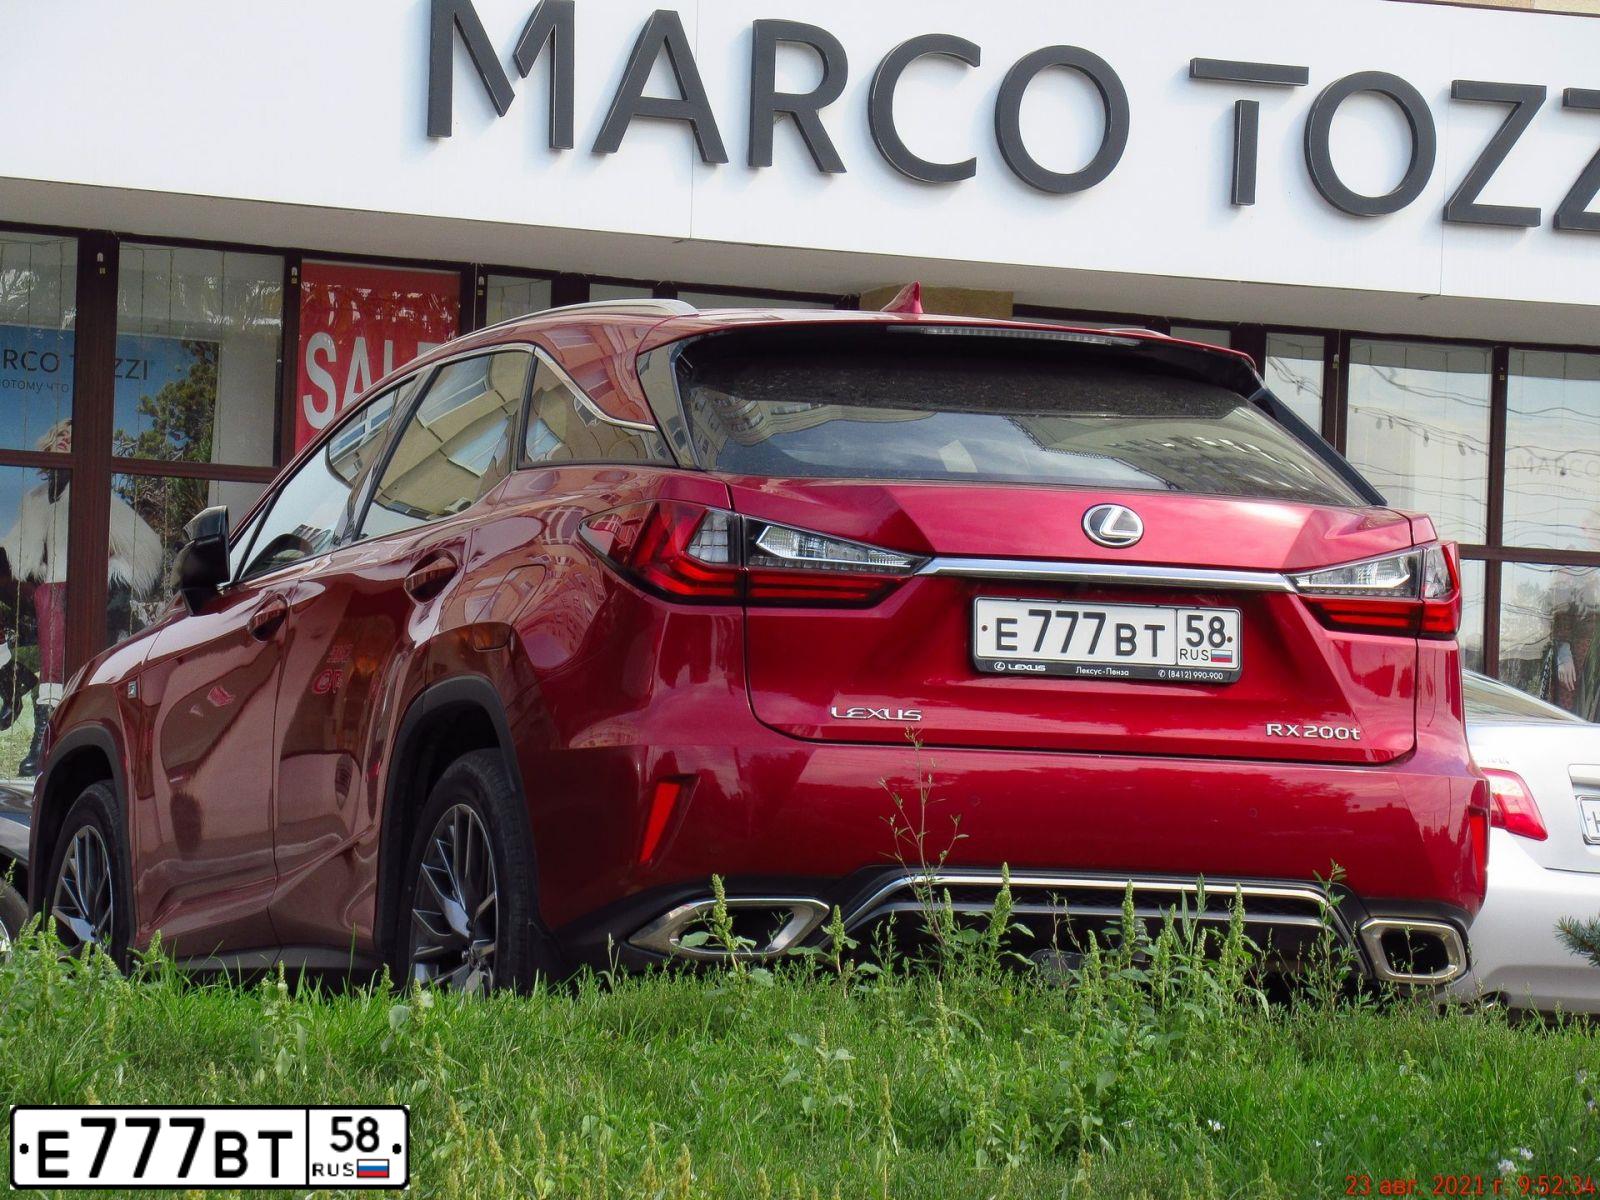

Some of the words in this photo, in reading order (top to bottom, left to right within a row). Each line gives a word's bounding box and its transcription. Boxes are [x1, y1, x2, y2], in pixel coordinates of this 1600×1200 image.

[427, 0, 1130, 194] MARCO
[303, 331, 442, 430] SA
[1185, 614, 1226, 648] 58
[1179, 648, 1209, 661] RUS
[1008, 663, 1046, 672] LEXUS
[1168, 669, 1192, 680] (8412)
[1193, 671, 1223, 680] 990-900
[830, 706, 922, 721] LEXUS
